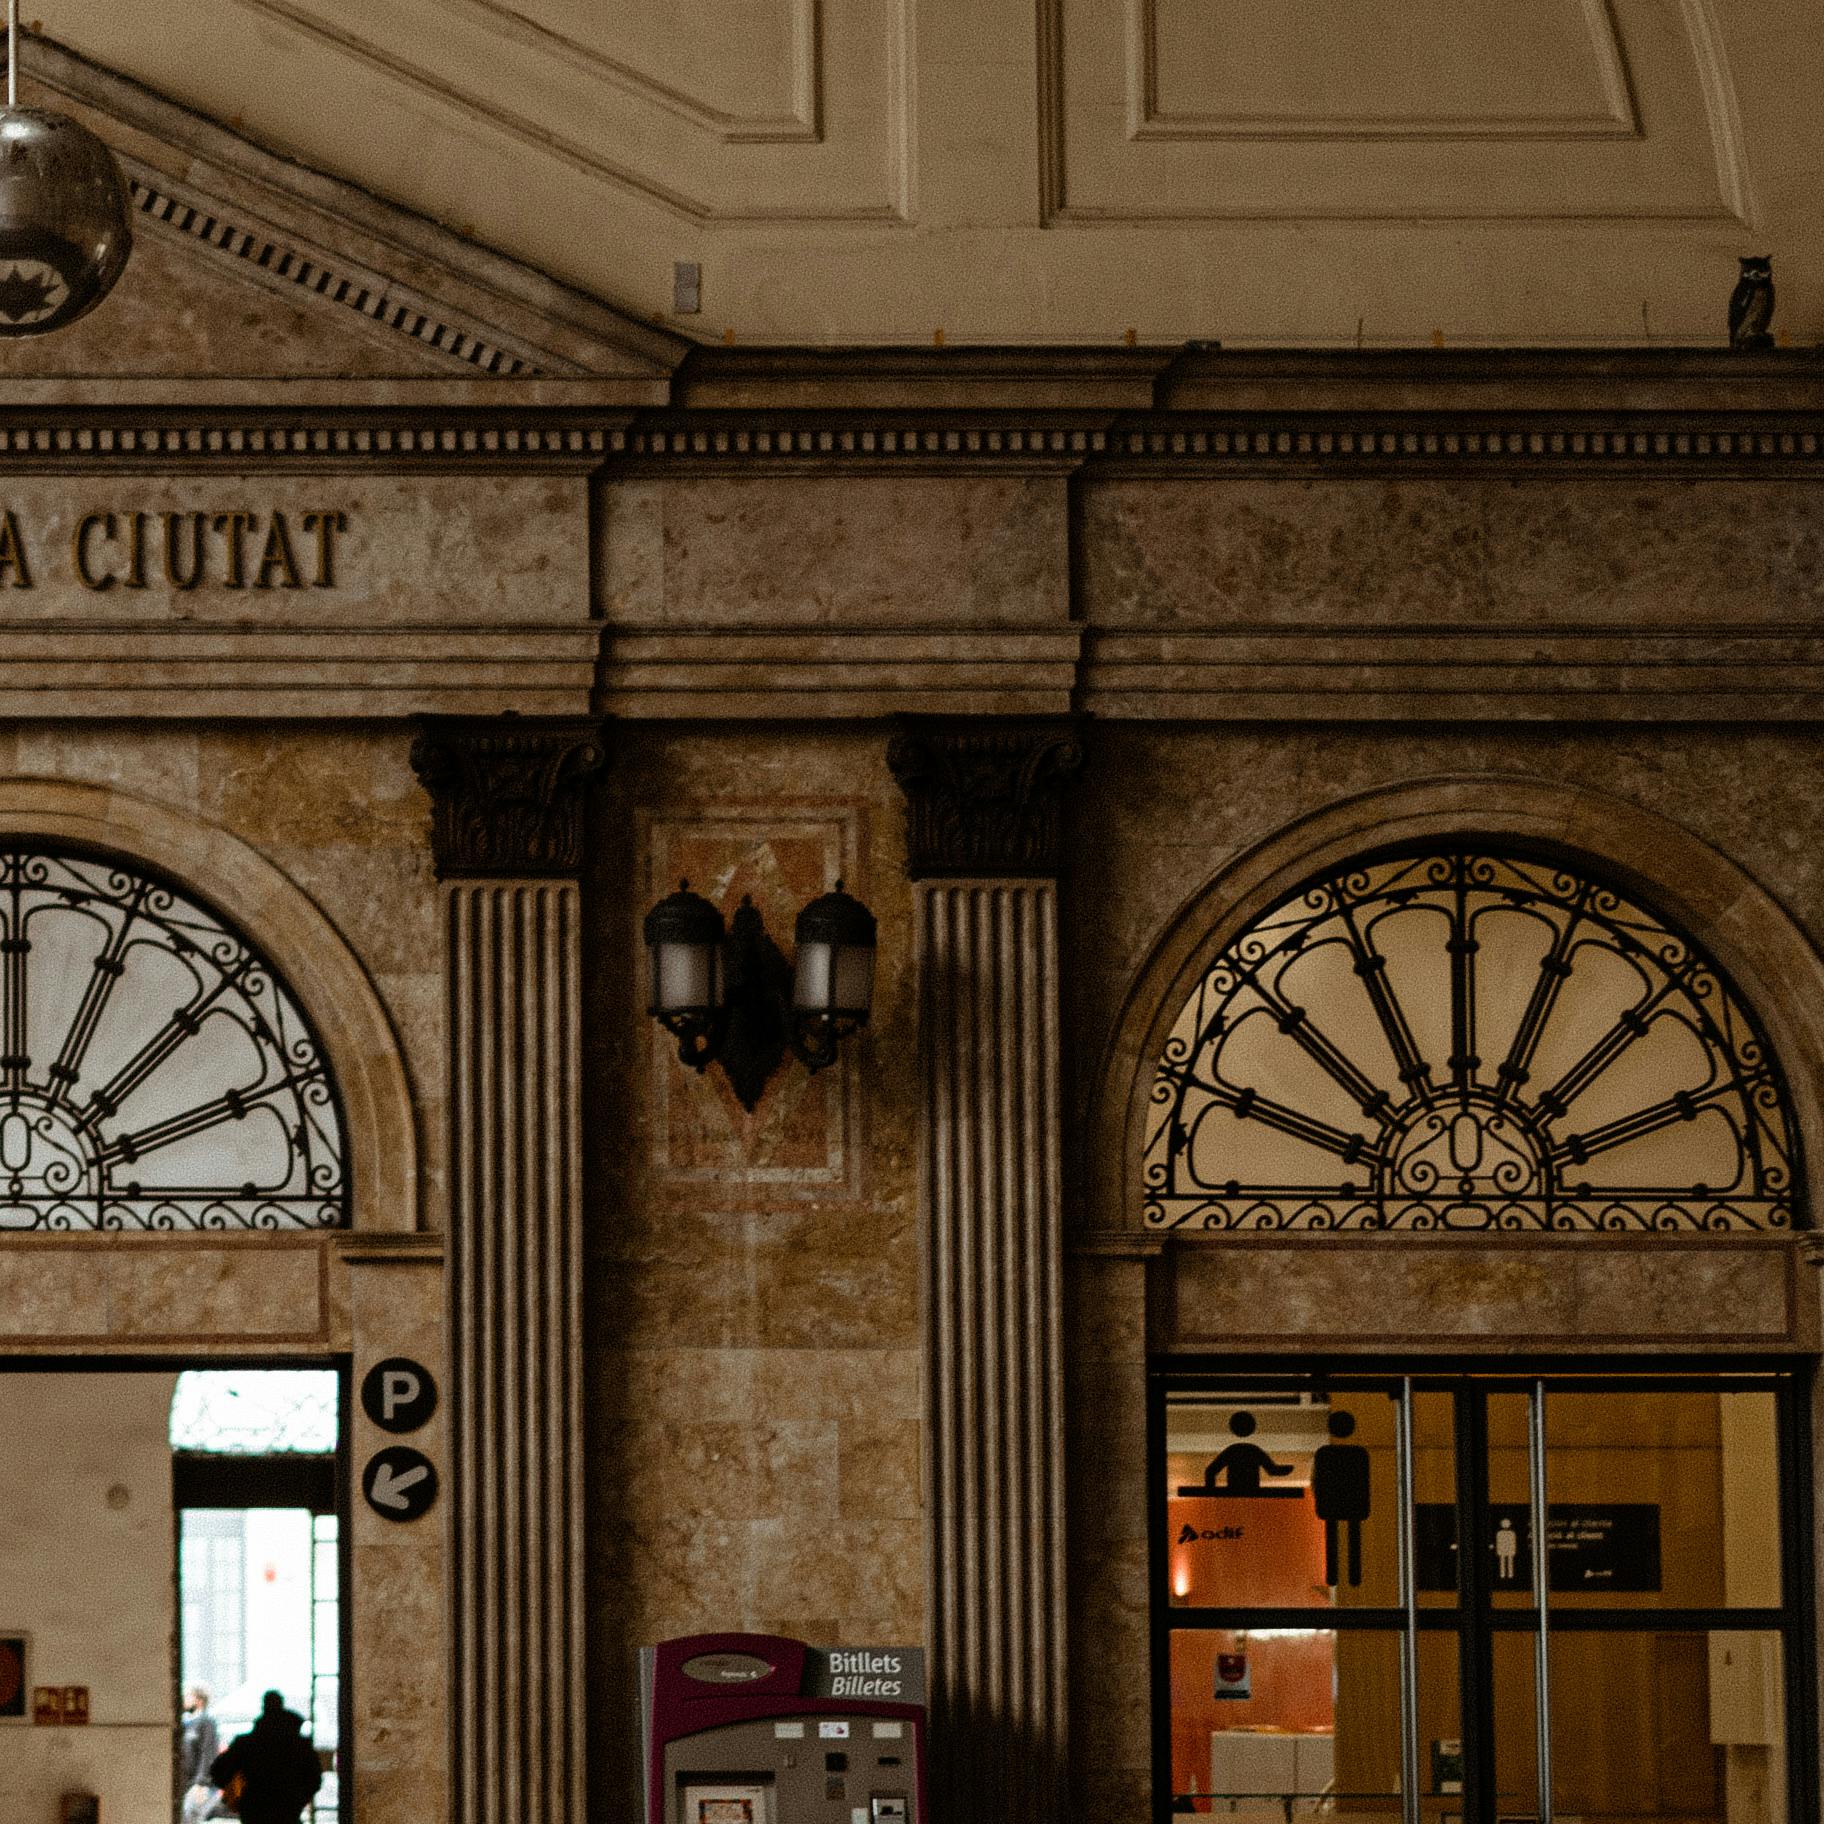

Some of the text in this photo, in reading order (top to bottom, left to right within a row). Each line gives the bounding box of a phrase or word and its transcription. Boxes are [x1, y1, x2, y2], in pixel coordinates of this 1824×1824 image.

[75, 509, 348, 592] CIUTAT
[382, 1370, 420, 1420] P
[829, 1652, 902, 1674] Bitllets
[831, 1676, 902, 1696] Billetes
